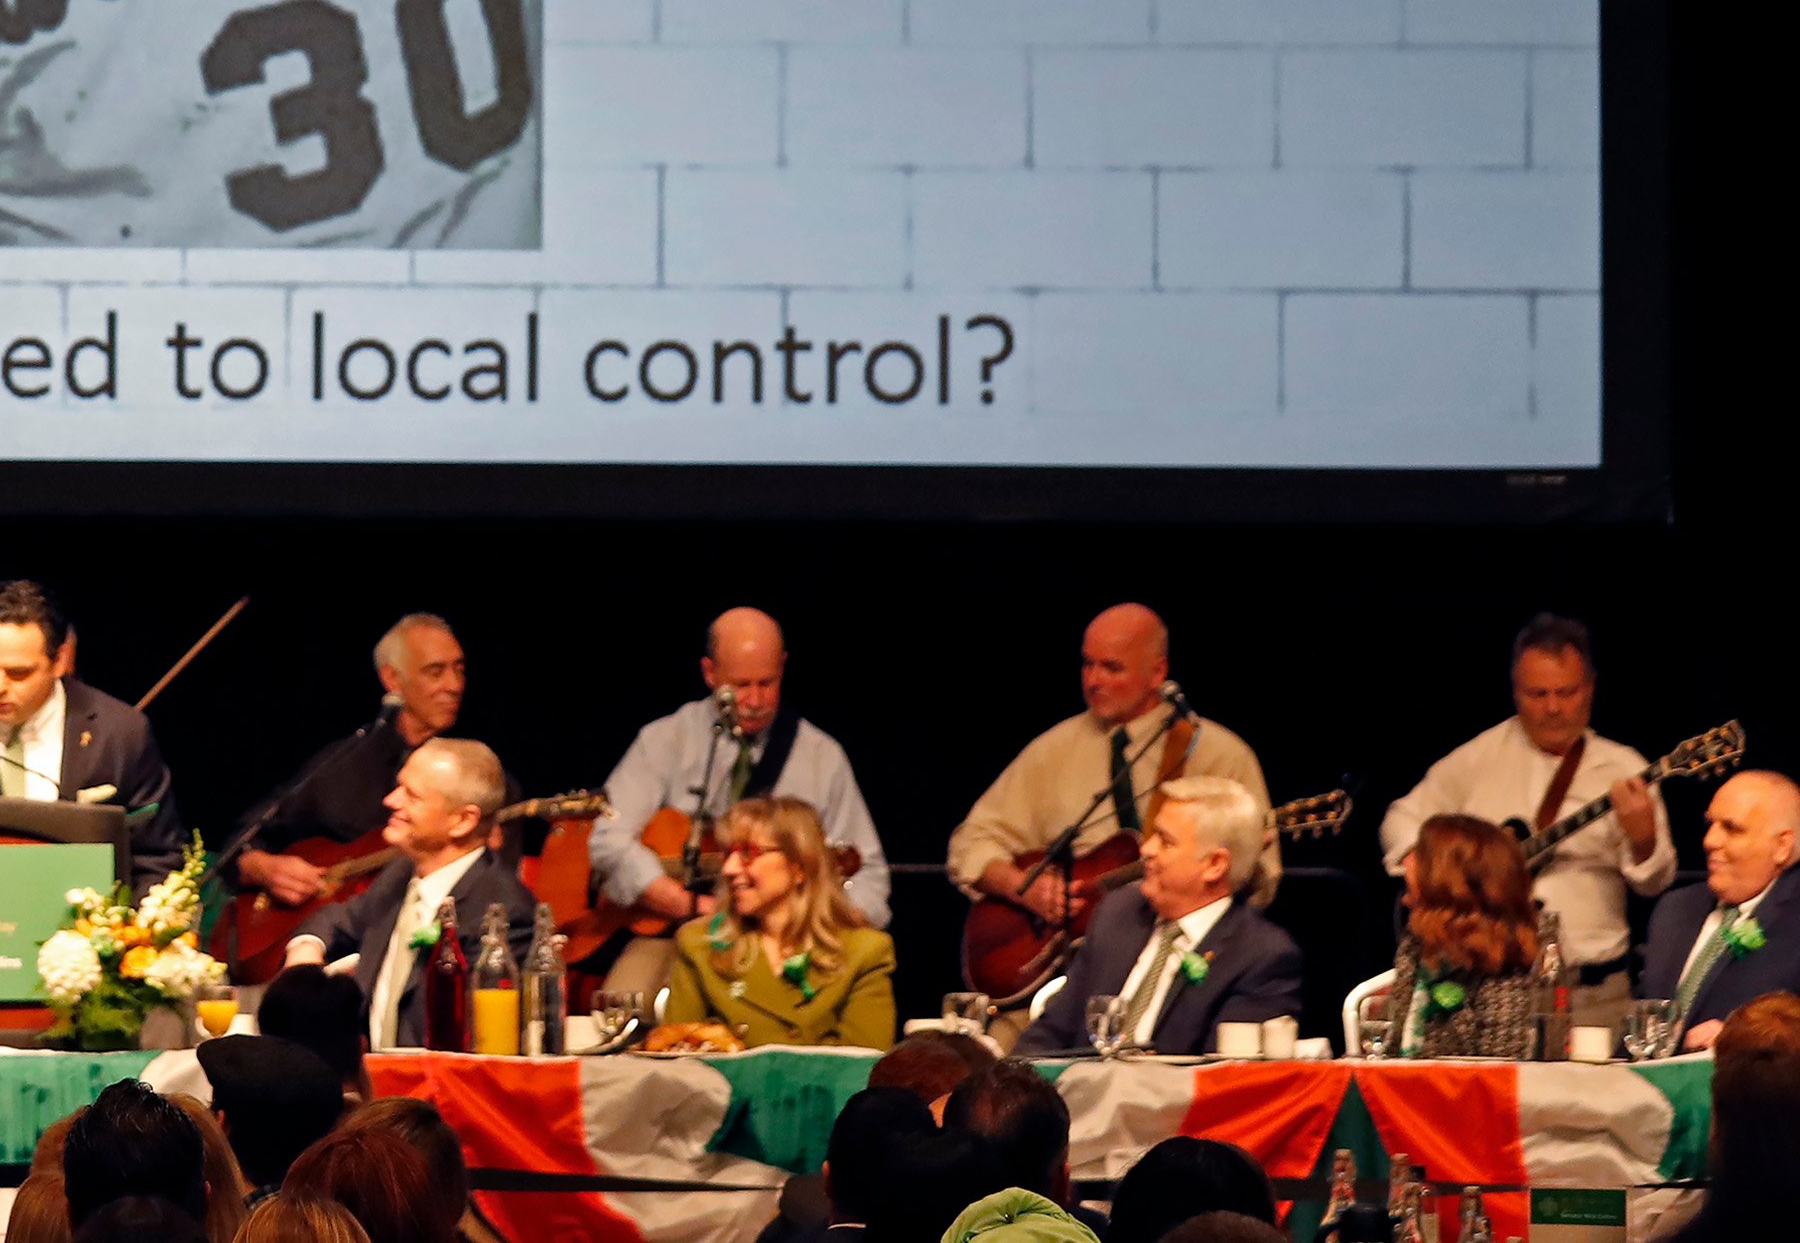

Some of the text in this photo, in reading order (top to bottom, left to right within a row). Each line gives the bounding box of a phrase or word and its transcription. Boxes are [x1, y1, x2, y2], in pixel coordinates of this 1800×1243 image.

[165, 323, 270, 401] to
[311, 312, 540, 404] local
[583, 313, 1016, 407] control?
